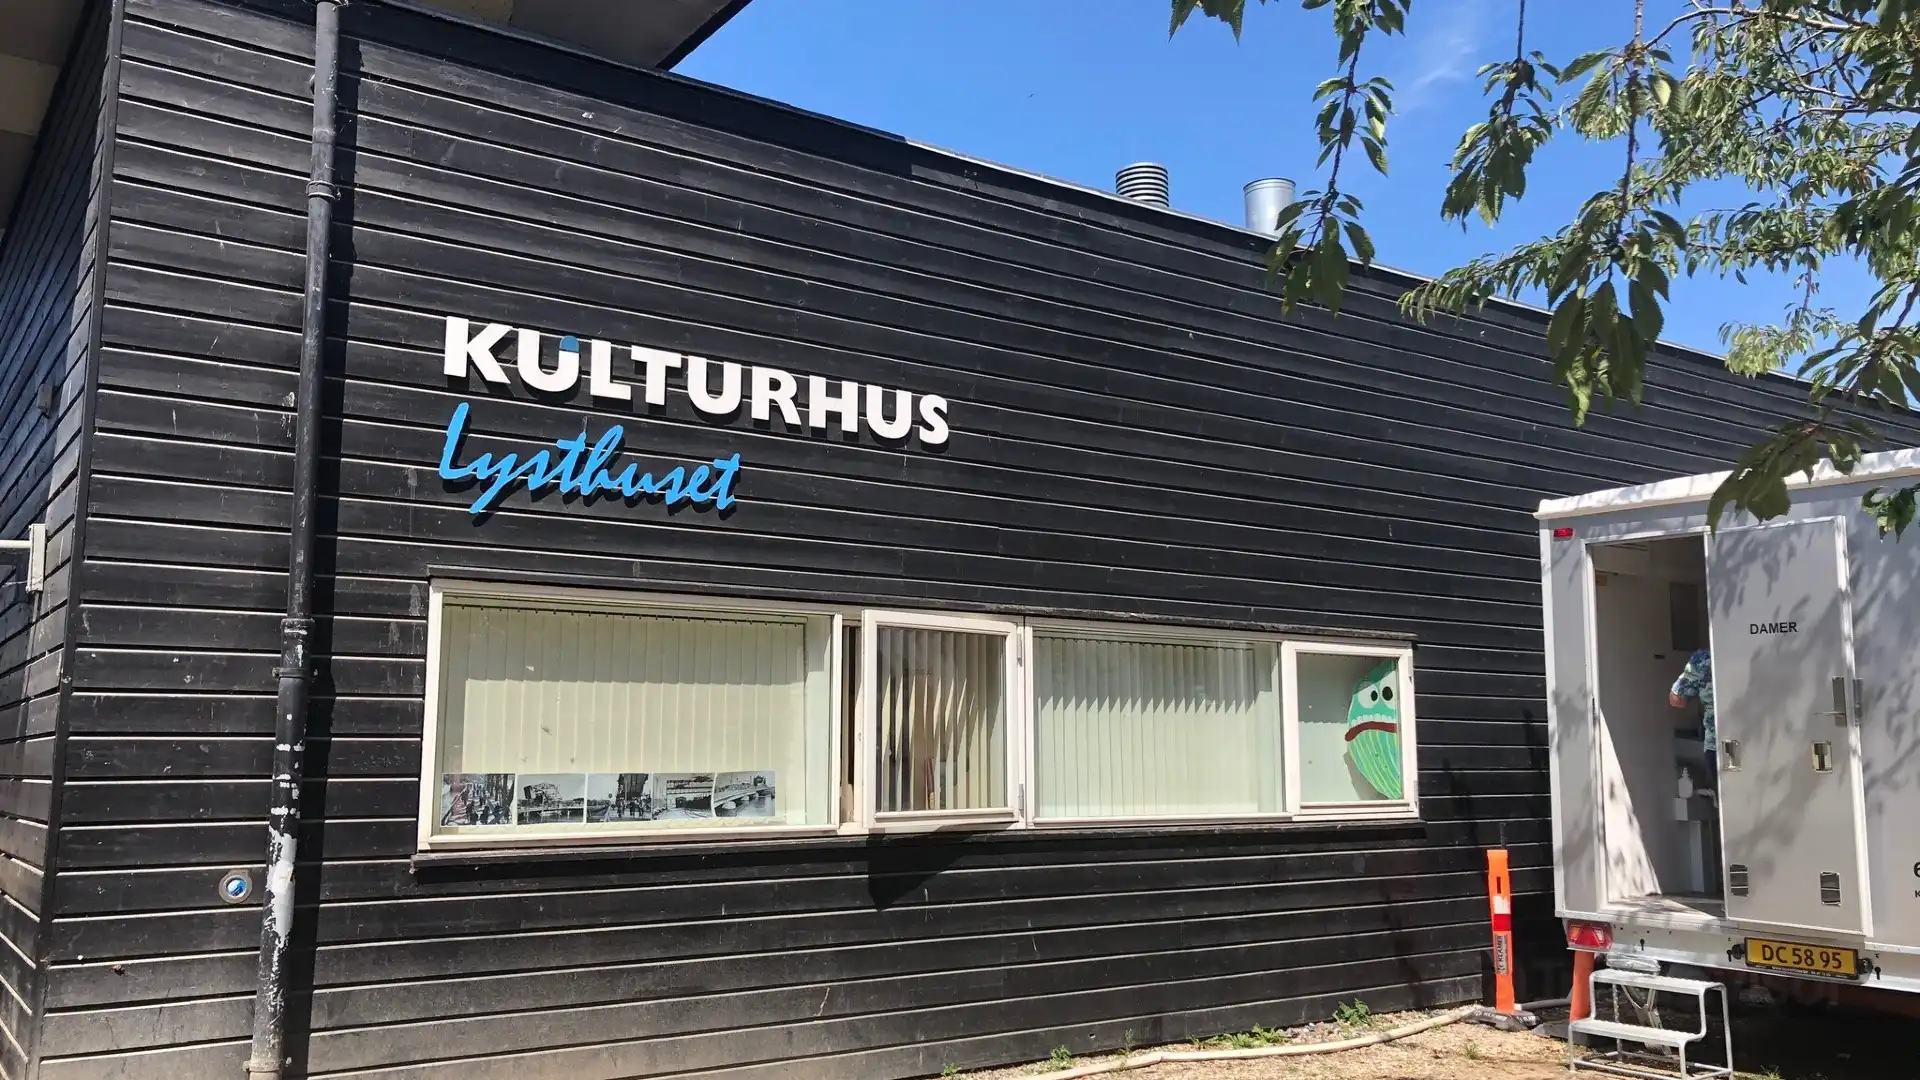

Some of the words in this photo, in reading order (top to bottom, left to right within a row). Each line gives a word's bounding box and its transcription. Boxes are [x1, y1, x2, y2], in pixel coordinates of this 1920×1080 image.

[443, 315, 950, 445] KULTURHUS
[438, 402, 740, 514] Lysthuset
[1749, 621, 1799, 635] DAMER
[1761, 944, 1787, 964] DC
[1791, 947, 1815, 967] 58
[1819, 950, 1842, 969] 95
